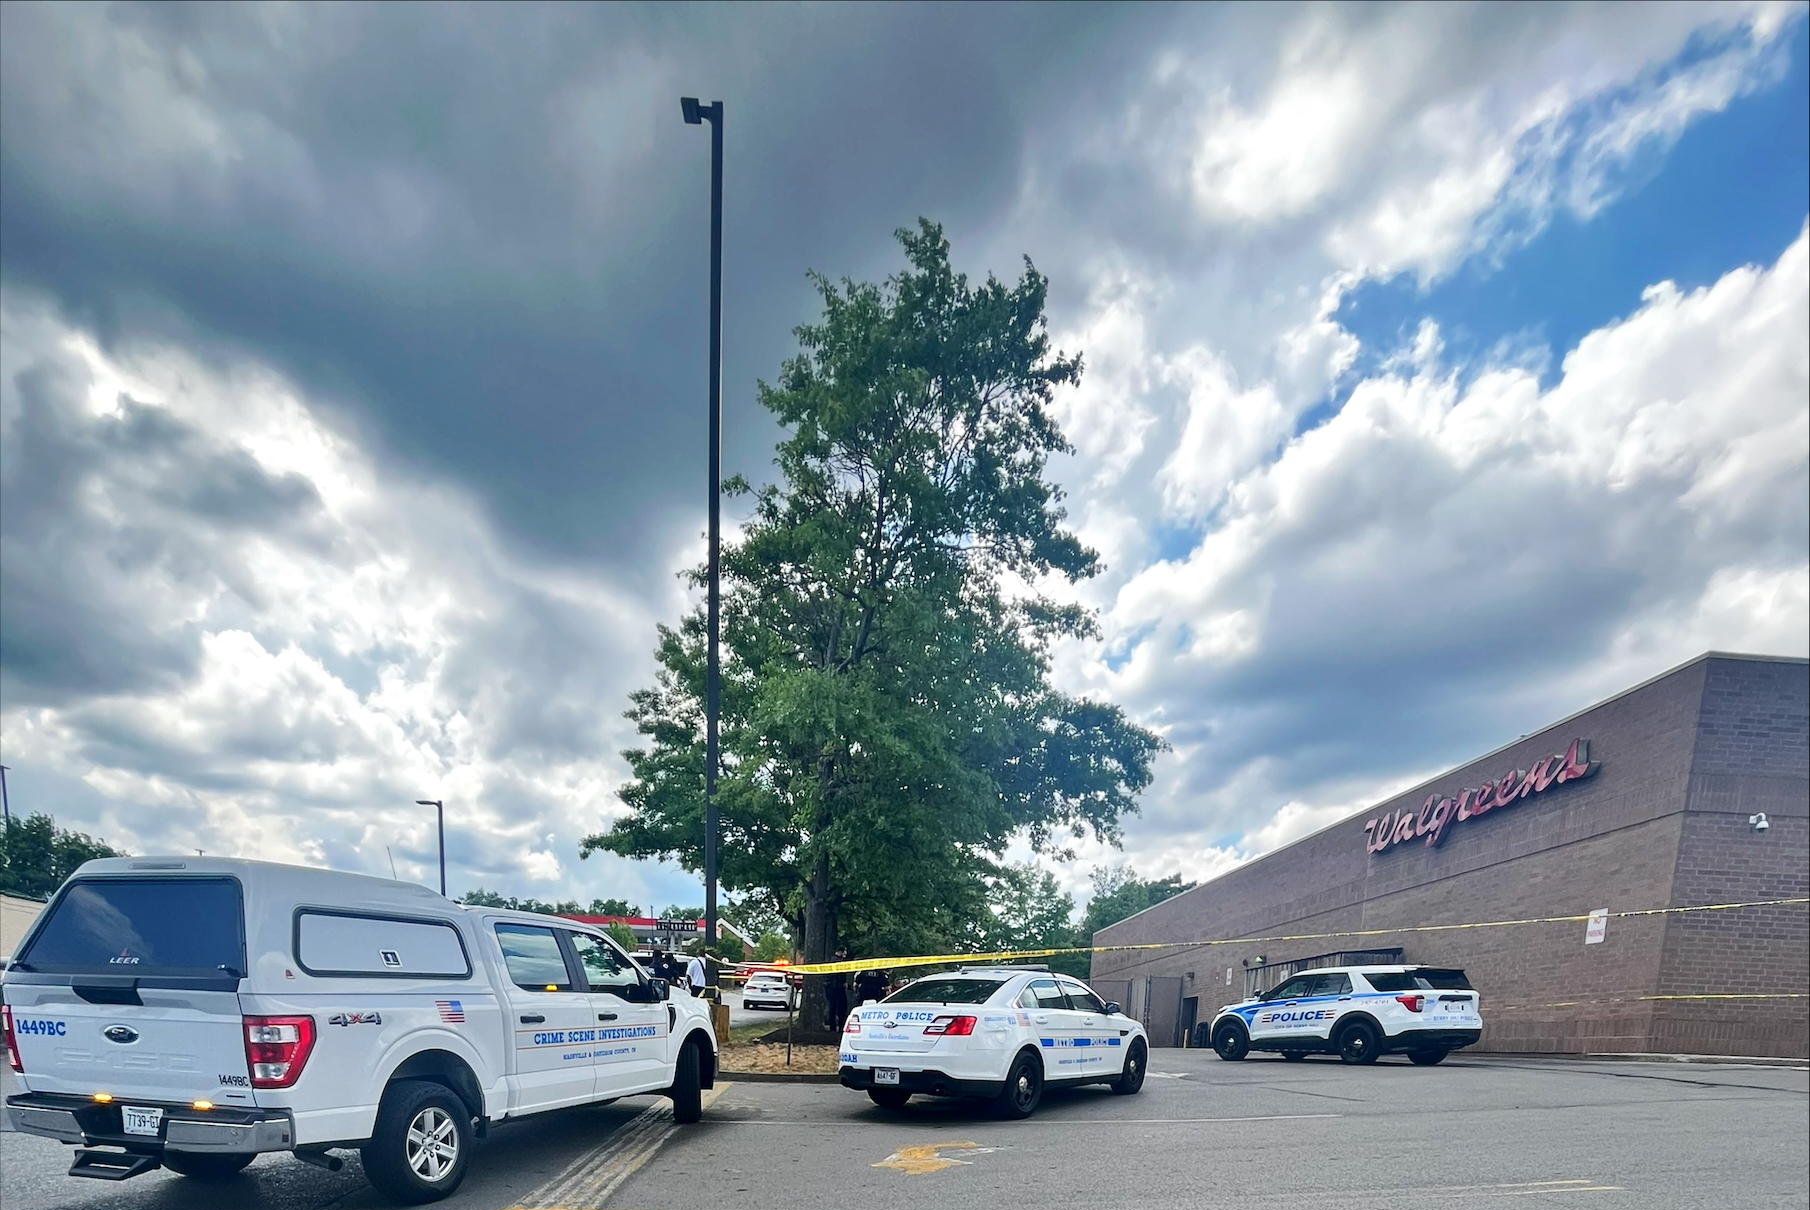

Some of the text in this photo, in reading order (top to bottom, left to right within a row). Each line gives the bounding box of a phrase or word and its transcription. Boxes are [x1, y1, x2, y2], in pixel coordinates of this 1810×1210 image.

[1364, 738, 1595, 854] Walgreens
[109, 957, 140, 965] LEER
[861, 1011, 934, 1021] METRO POLICE
[1271, 1010, 1326, 1022] POLICE
[16, 1019, 66, 1036] 1449BC
[534, 1026, 656, 1045] CRIME SCENE INVESTIGATIONS
[218, 1074, 249, 1087] 1449BC
